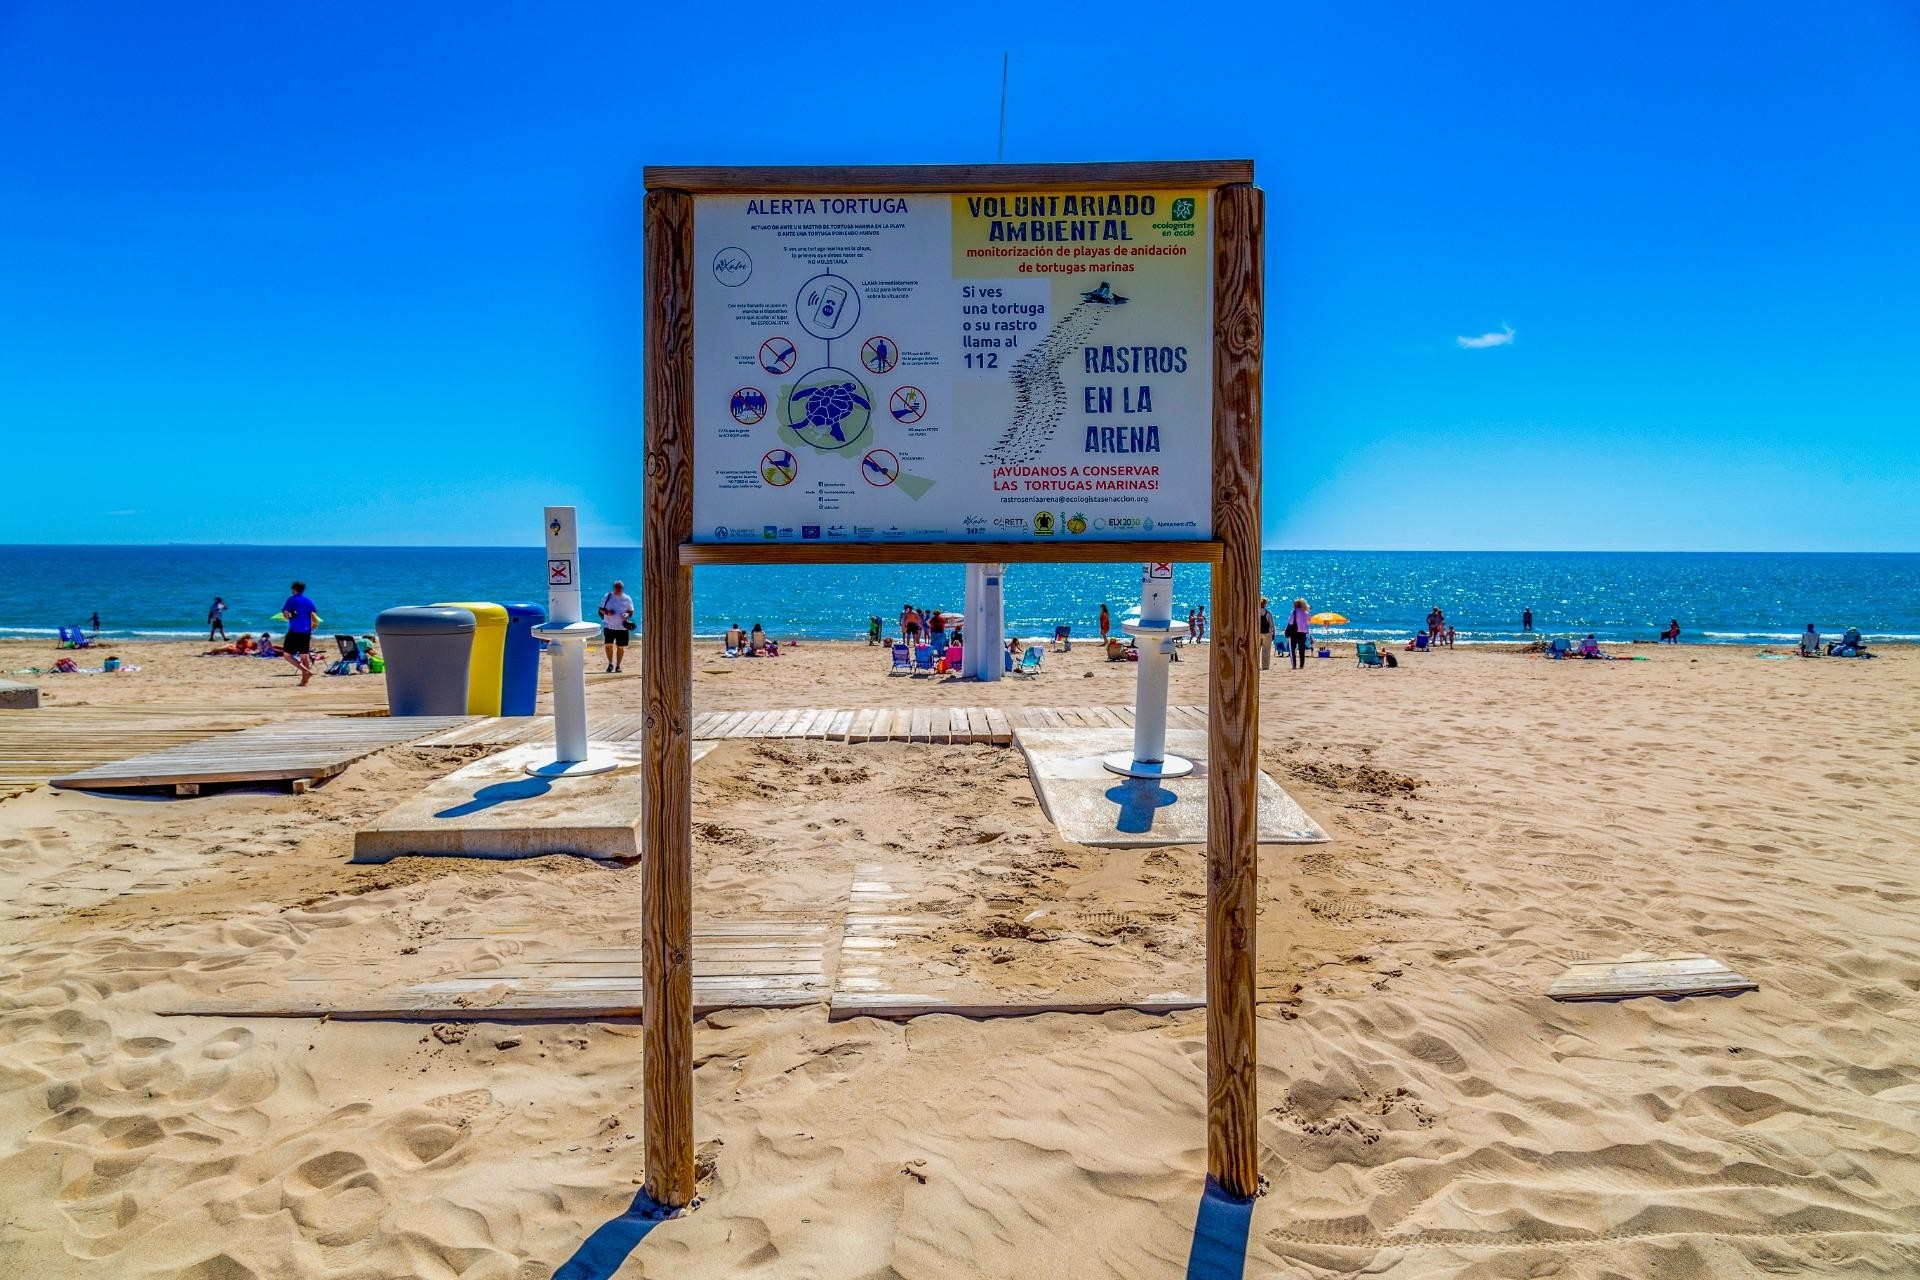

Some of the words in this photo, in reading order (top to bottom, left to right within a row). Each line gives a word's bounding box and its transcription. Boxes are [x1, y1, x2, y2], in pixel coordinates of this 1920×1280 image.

[747, 199, 816, 215] ALERTA
[820, 198, 908, 214] TORTUGA
[967, 195, 1155, 217] VOLUNTARIADO
[989, 219, 1134, 242] AMBIENTAL
[1152, 222, 1194, 231] ecologistes
[967, 246, 1053, 257] monitorización
[1056, 245, 1070, 256] de
[1074, 246, 1110, 258] playas
[1114, 245, 1128, 256] de
[1131, 245, 1187, 256] anidación
[1019, 262, 1033, 272] de
[1036, 263, 1086, 274] tortugas
[1089, 262, 1135, 272] marinas
[963, 286, 975, 297] Si
[979, 289, 1002, 297] ves
[963, 305, 987, 314] una
[992, 304, 1044, 315] tortuga
[963, 323, 971, 331] o
[975, 323, 991, 331] su
[995, 321, 1036, 331] rastro
[963, 335, 1001, 347] llama
[1005, 335, 1017, 347] al
[964, 352, 998, 368] 112
[1085, 345, 1188, 374] RASTROS
[1084, 386, 1112, 413] EN
[1124, 385, 1152, 413] LA
[1085, 425, 1160, 453] ARENA
[994, 464, 1067, 478] ¡AYÚDANOS
[1070, 467, 1080, 476] A
[1082, 466, 1159, 476] CONSERVAR
[994, 481, 1017, 491] LAS
[1024, 480, 1092, 491] TORTUGAS
[1096, 480, 1158, 491] MARINAS!
[1000, 495, 1148, 504] rastrosenlaarena@ecologistasenaccion.org
